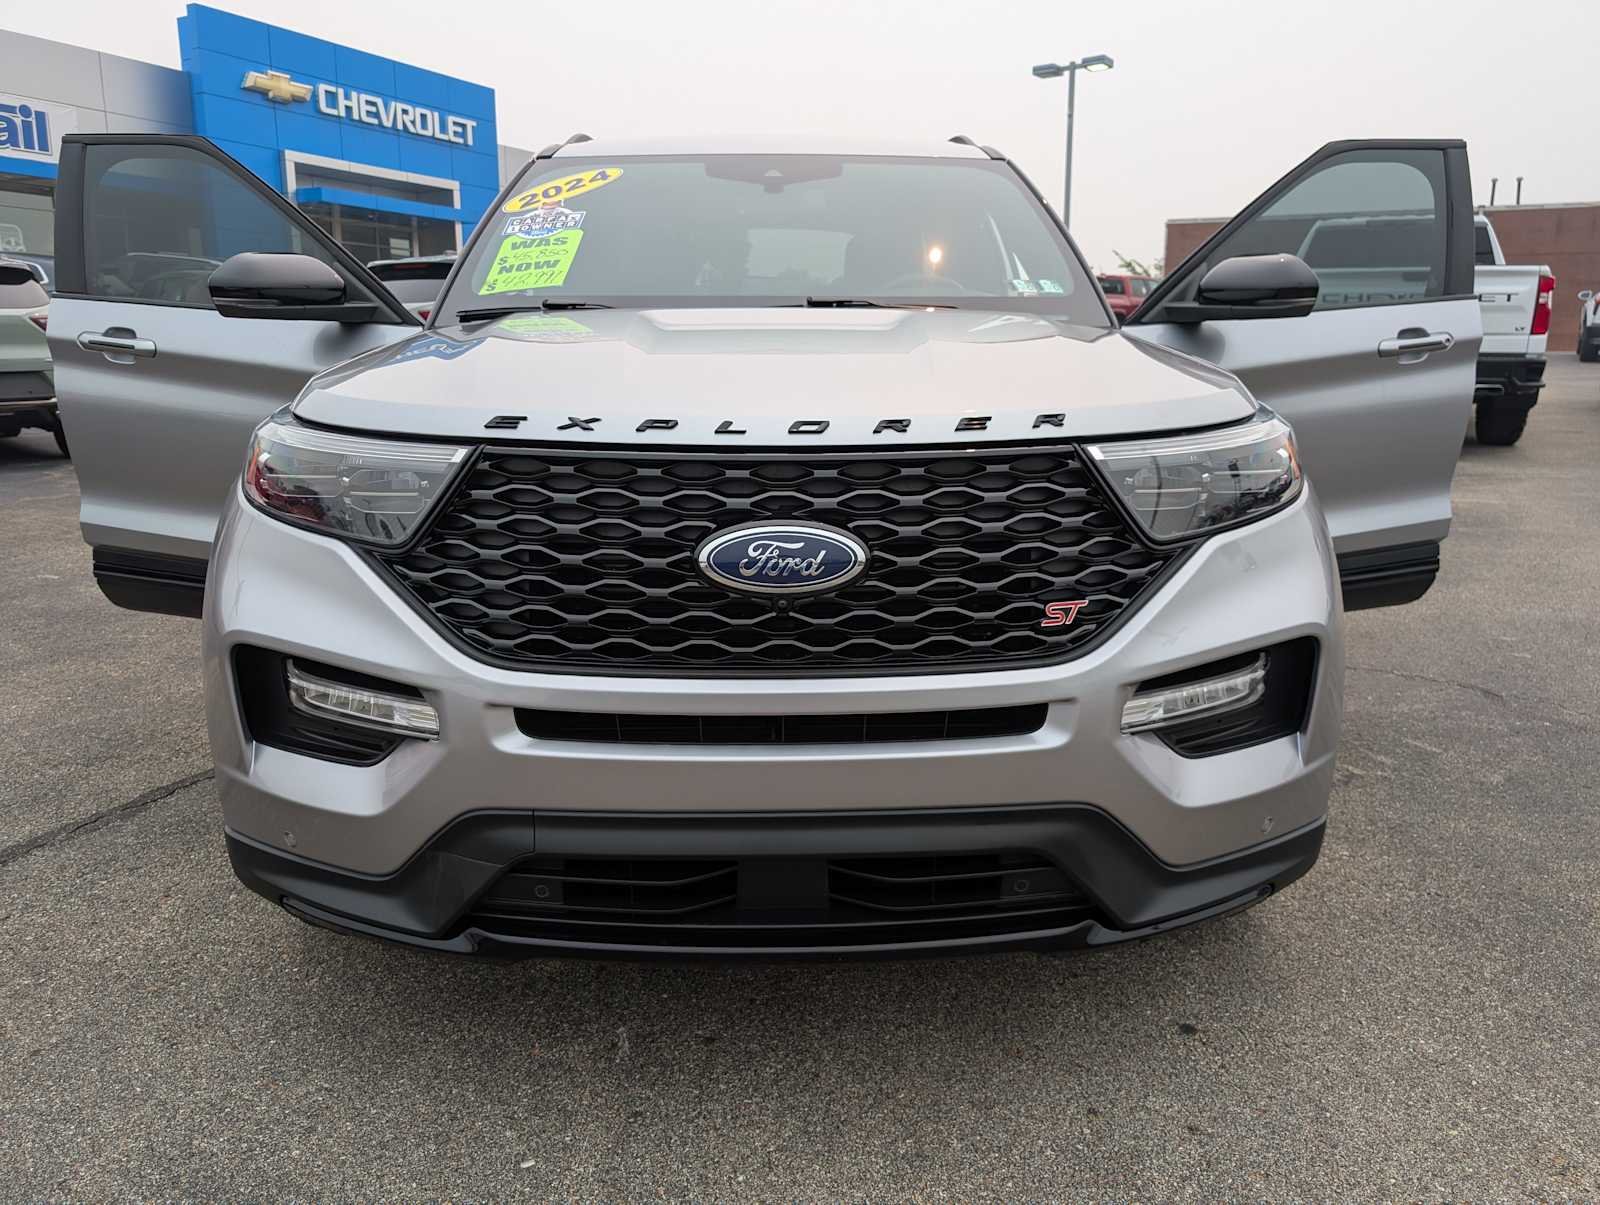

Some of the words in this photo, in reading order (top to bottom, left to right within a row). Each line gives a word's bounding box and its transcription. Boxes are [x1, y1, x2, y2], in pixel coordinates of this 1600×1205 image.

[0, 104, 50, 153] ail
[318, 83, 477, 146] CHEVROLET
[518, 170, 612, 209] 2024
[511, 236, 569, 250] WAS
[497, 259, 561, 275] NOW
[484, 413, 1066, 435] EXPLORER
[738, 540, 826, 577] Ford
[1040, 600, 1089, 627] ST
